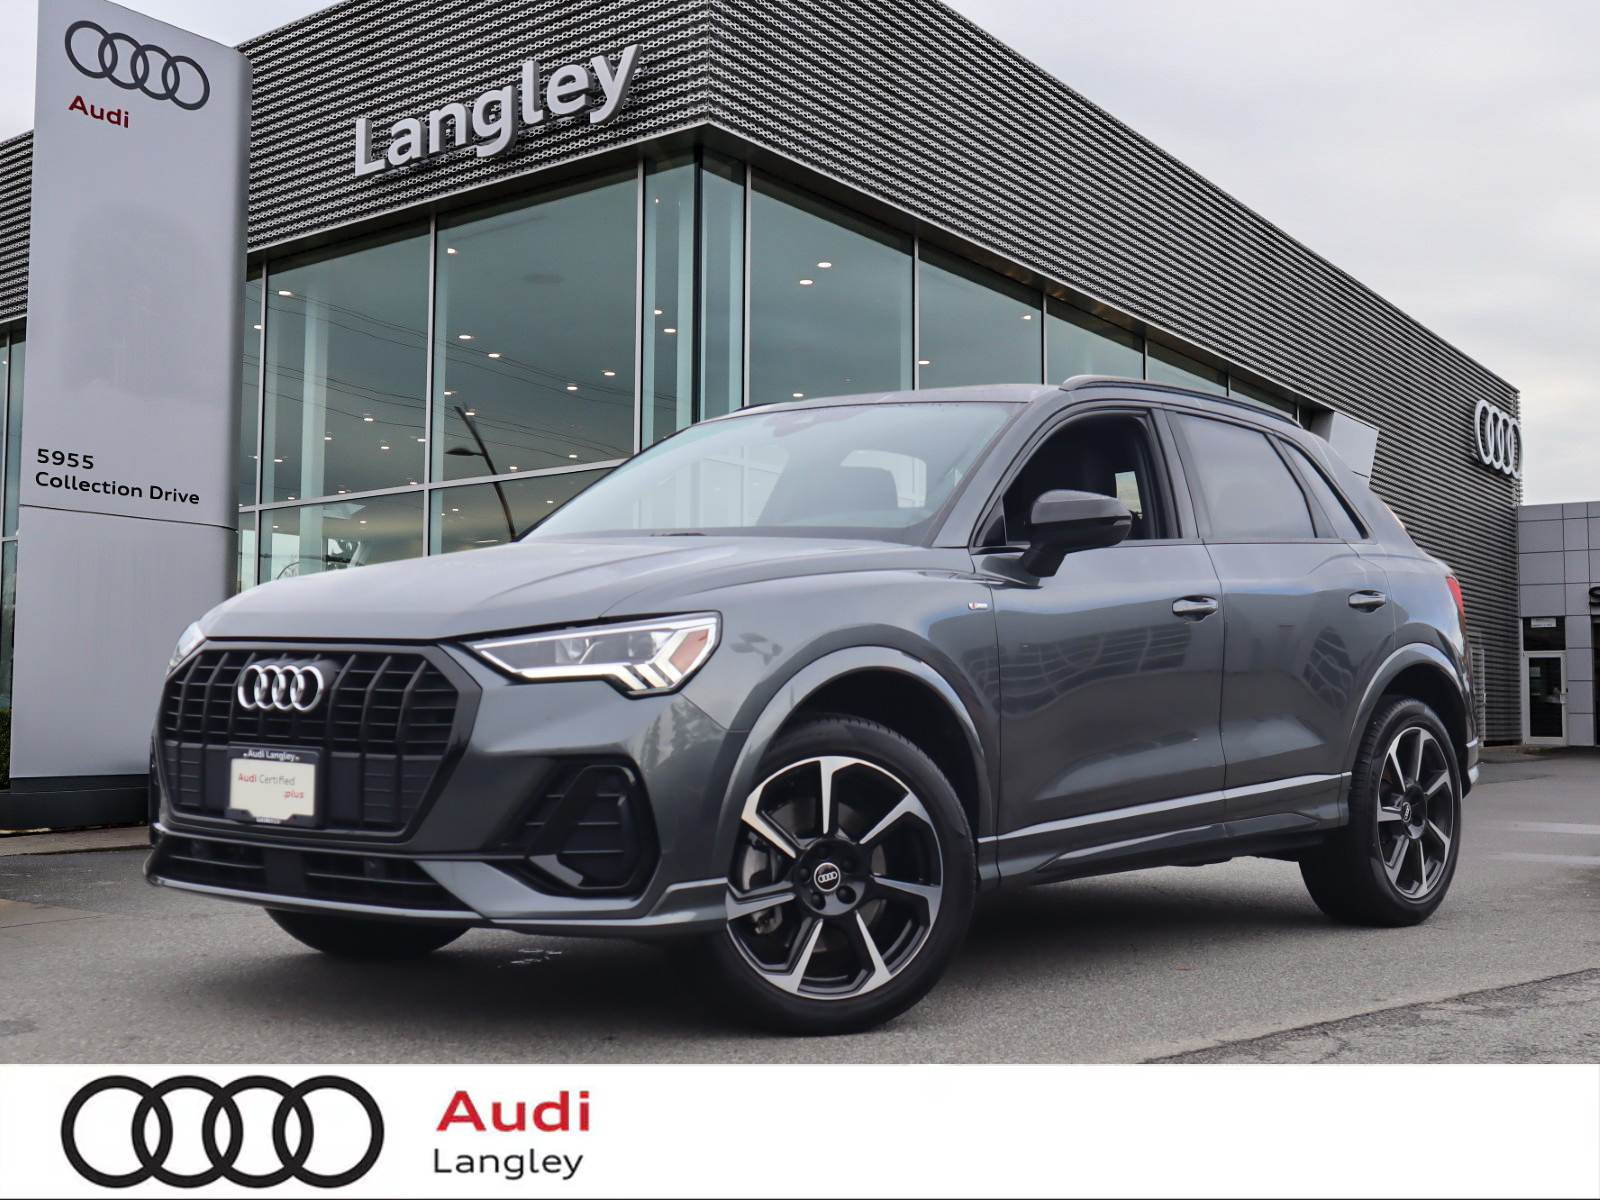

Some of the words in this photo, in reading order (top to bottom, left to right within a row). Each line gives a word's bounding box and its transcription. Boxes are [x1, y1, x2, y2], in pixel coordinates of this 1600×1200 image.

[68, 95, 129, 129] Audi
[355, 44, 643, 177] Langley
[37, 448, 94, 470] 5955
[35, 471, 143, 498] Collection
[149, 485, 200, 505] Drive
[247, 749, 264, 758] Audi
[265, 751, 296, 762] Langley
[238, 773, 257, 783] Audi
[258, 774, 295, 786] Certified
